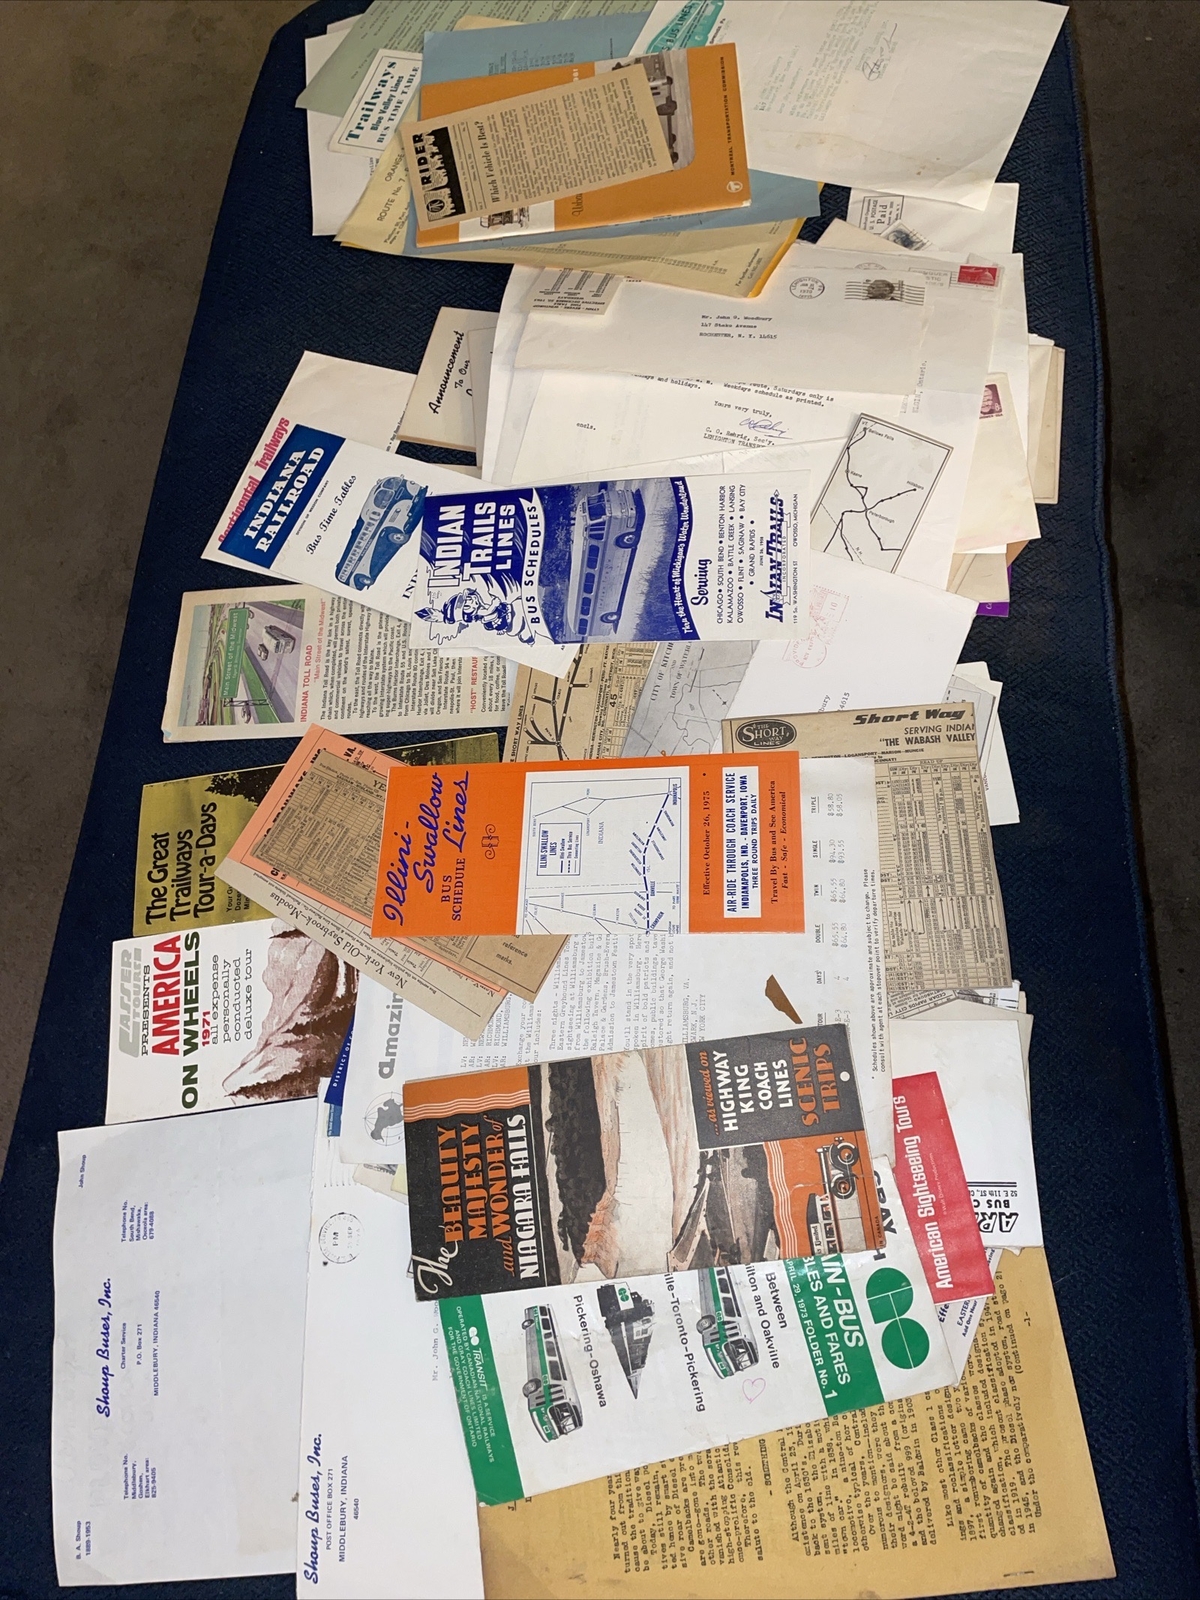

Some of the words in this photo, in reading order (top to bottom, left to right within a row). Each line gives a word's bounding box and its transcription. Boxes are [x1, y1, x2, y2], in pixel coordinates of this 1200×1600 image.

[389, 75, 404, 93] Lines
[720, 56, 728, 92] COMMISSION
[345, 61, 397, 142] Trailways
[370, 116, 384, 131] Blue
[376, 94, 396, 115] Valley
[377, 126, 390, 143] BUS
[387, 99, 404, 122] TIME
[400, 66, 420, 95] TABLE
[723, 95, 733, 144] TRANSPORTATION
[475, 120, 487, 141] Best?
[412, 133, 432, 186] RIDER
[483, 151, 496, 178] Vehicle
[727, 146, 735, 176] MONTREAL
[488, 179, 500, 203] Which
[876, 205, 888, 224] Paid
[428, 330, 465, 414] Announcement
[254, 417, 290, 470] Trailways
[244, 450, 306, 539] INDIANA
[256, 447, 325, 553] RAILROAD
[306, 535, 322, 555] Bus
[319, 508, 338, 532] Time
[334, 475, 356, 506] Tables
[675, 481, 690, 520] Wonderland
[428, 505, 465, 588] INDIAN
[461, 501, 496, 582] TRAILS
[496, 505, 515, 569] LINES
[524, 506, 541, 586] SCHEDULES
[679, 522, 689, 542] Water
[672, 544, 686, 578] Michigan's
[672, 578, 682, 586] of
[691, 559, 712, 606] Serving
[526, 596, 540, 624] BUS
[673, 586, 684, 606] Heart
[225, 661, 233, 680] Street
[229, 612, 239, 640] Midwest
[682, 618, 693, 634] Thru
[303, 669, 311, 687] TOLL
[305, 645, 313, 666] ROAD
[301, 691, 309, 722] INDIANA
[853, 711, 920, 726] Short
[925, 709, 966, 721] Way
[442, 770, 469, 853] Lines
[725, 773, 736, 803] SERVICE
[412, 772, 444, 893] Swallow
[703, 814, 711, 827] 26,
[726, 808, 736, 833] COACH
[740, 796, 749, 836] DAVENPORT,
[149, 832, 170, 883] Great
[170, 829, 195, 921] Trailways
[194, 802, 217, 918] Tour-a-Days
[382, 821, 412, 926] Illini-
[726, 839, 736, 873] THROUGH
[740, 844, 749, 857] IND.
[770, 847, 778, 862] Bus
[770, 865, 780, 875] By
[146, 888, 167, 925] The
[440, 874, 452, 903] BUS
[452, 858, 466, 921] SCHEDULE
[726, 879, 737, 912] AIR-RIDE
[740, 860, 750, 909] INDIANAPOLIS,
[770, 878, 778, 904] Travel
[142, 965, 150, 1056] PRESENTS
[152, 935, 181, 1055] AMERICA
[183, 932, 200, 1057] WHEELS
[212, 955, 220, 1020] expense
[222, 959, 231, 1043] personally
[233, 958, 241, 1042] conducted
[202, 1011, 210, 1047] 1971
[244, 985, 252, 1040] deluxe
[699, 1051, 708, 1066] on
[790, 1038, 819, 1126] SCENIC
[815, 1043, 841, 1113] TRIPS
[182, 1064, 199, 1109] ON
[700, 1068, 715, 1107] viewed
[714, 1050, 739, 1131] HIGHWAY
[736, 1064, 754, 1113] KING
[754, 1062, 774, 1110] COACH
[773, 1060, 793, 1108] LINES
[484, 1116, 504, 1131] of
[892, 1096, 913, 1133] Tours
[506, 1114, 529, 1178] FALLS
[437, 1126, 464, 1242] BEAUTY
[460, 1123, 488, 1239] MAJESTY
[485, 1134, 511, 1238] WONDER
[901, 1136, 938, 1217] Sightseeing
[512, 1182, 540, 1279] NIAGARA
[924, 1222, 954, 1288] American
[412, 1241, 458, 1294] The
[496, 1236, 516, 1277] and
[98, 1278, 112, 1308] Inc.
[766, 1272, 788, 1329] Between
[97, 1312, 112, 1360] Buses,
[574, 1295, 608, 1407] Pickering-Oshawa
[754, 1295, 766, 1317] and
[760, 1320, 780, 1369] Oakville
[814, 1296, 834, 1329] AND
[825, 1333, 851, 1385] FARES
[152, 1346, 160, 1396] MIDDLEBURY,
[473, 1348, 488, 1391] TRANSIT
[803, 1320, 823, 1366] FOLDER
[818, 1369, 829, 1389] No.
[824, 1390, 838, 1400] 1
[96, 1366, 113, 1418] Shoup
[307, 1434, 322, 1467] Inc.
[305, 1471, 323, 1523] Buses,
[339, 1498, 348, 1562] MIDDLEBURY,
[304, 1527, 322, 1584] Shoup
